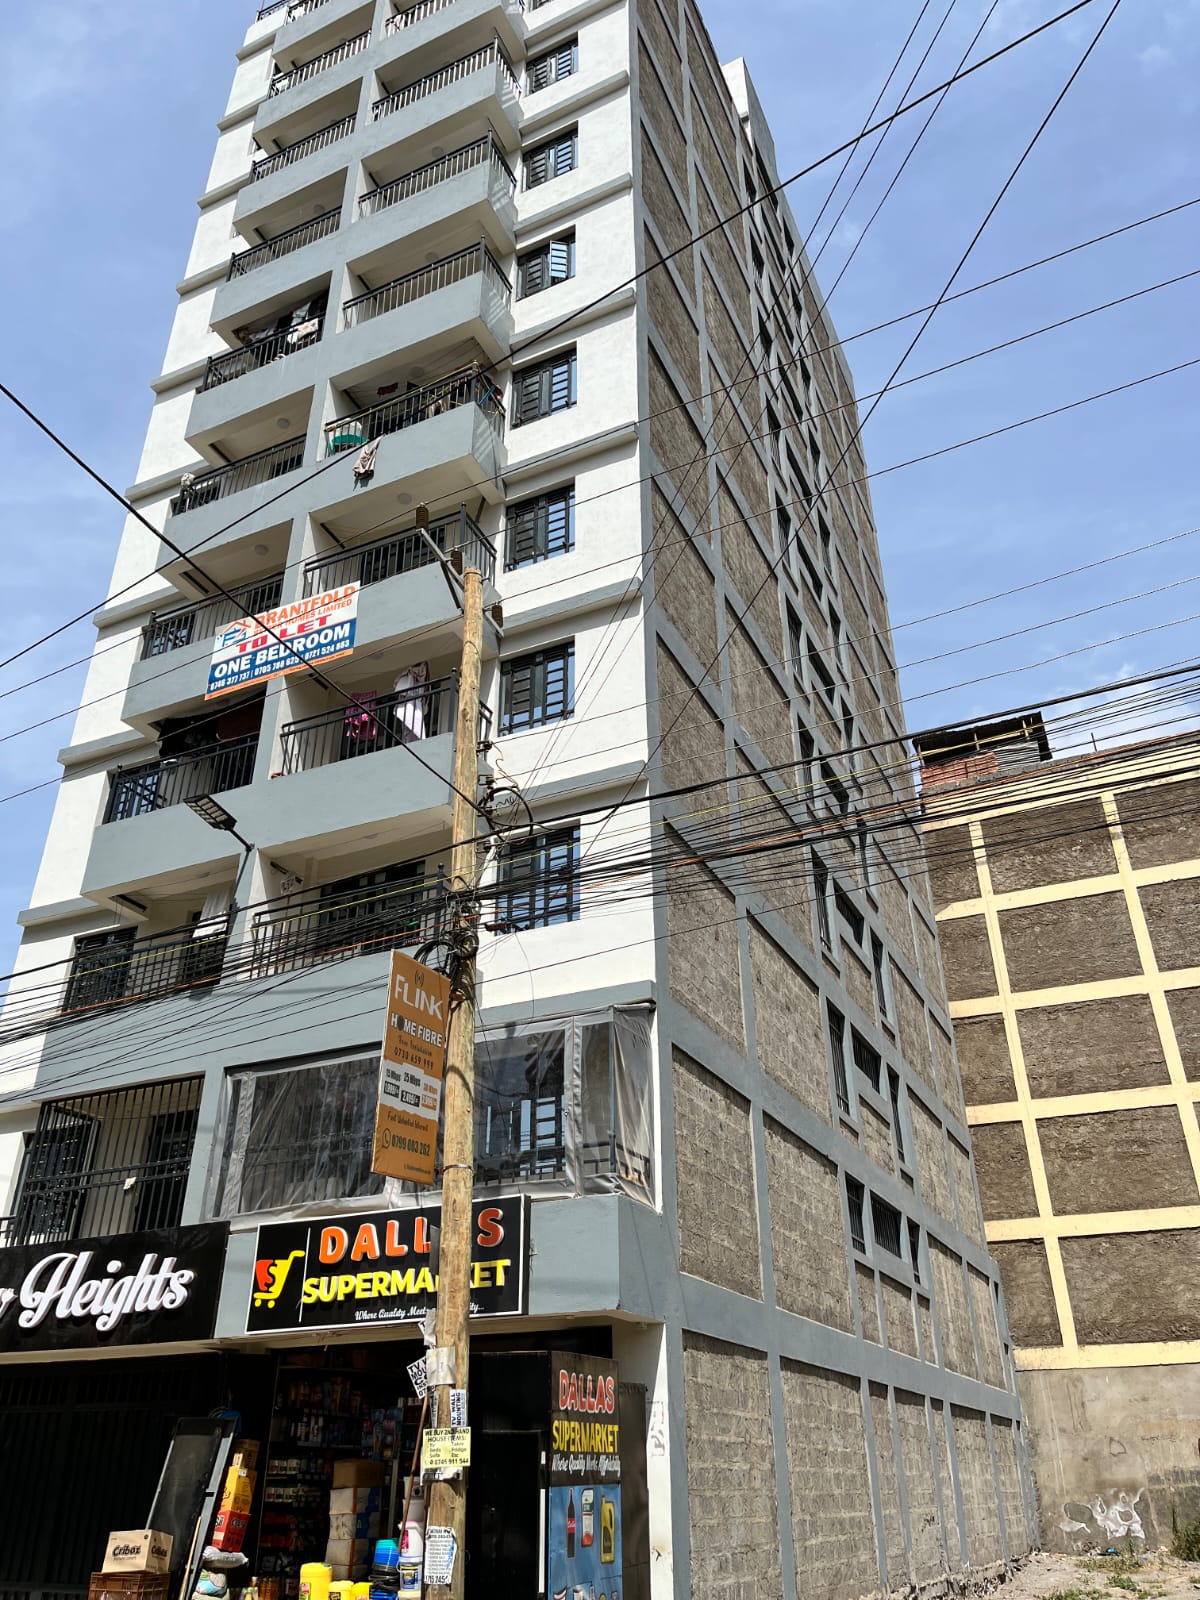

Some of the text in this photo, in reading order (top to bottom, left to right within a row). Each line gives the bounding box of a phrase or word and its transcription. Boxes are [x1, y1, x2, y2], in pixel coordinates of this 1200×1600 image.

[318, 599, 352, 615] LIMITED
[215, 656, 250, 677] ONE
[256, 623, 350, 665] BEDROOM
[236, 634, 268, 653] TO
[279, 614, 332, 638] LET
[394, 974, 443, 1021] FLINK
[418, 1025, 443, 1047] FIBRE
[404, 1072, 409, 1083] 25
[319, 1207, 505, 1265] DALLS
[18, 1251, 195, 1331] Heights
[302, 1259, 511, 1304] SUPERMAET
[354, 1310, 377, 1321] Where
[378, 1306, 406, 1320] Quality
[408, 1362, 419, 1373] TV
[559, 1369, 615, 1414] DALLAS
[452, 1416, 456, 1426] TV
[552, 1420, 619, 1454] SUPERMARKET
[569, 1454, 585, 1476] Quality
